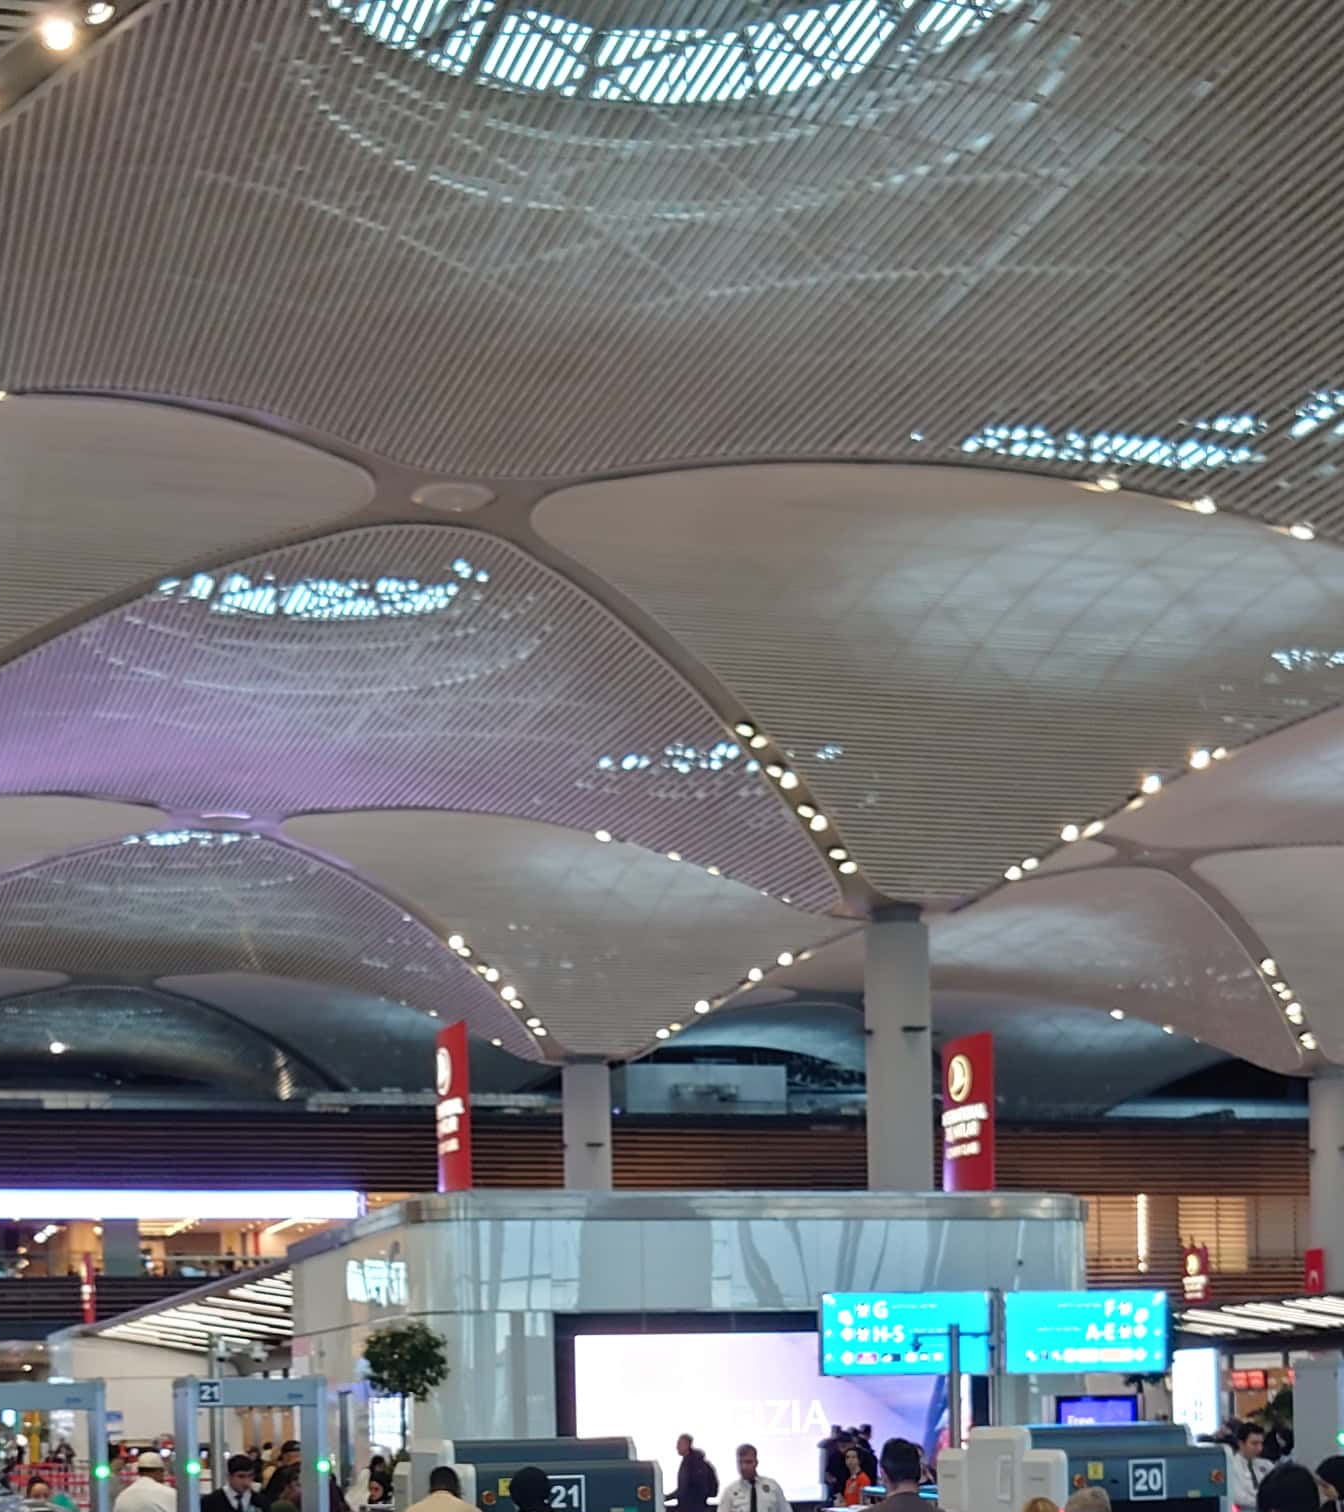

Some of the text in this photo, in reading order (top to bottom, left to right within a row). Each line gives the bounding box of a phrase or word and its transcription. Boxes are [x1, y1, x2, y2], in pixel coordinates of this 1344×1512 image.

[872, 1300, 889, 1320] G
[199, 1384, 220, 1401] 21
[1134, 1467, 1162, 1492] 20
[550, 1484, 579, 1509] 21
